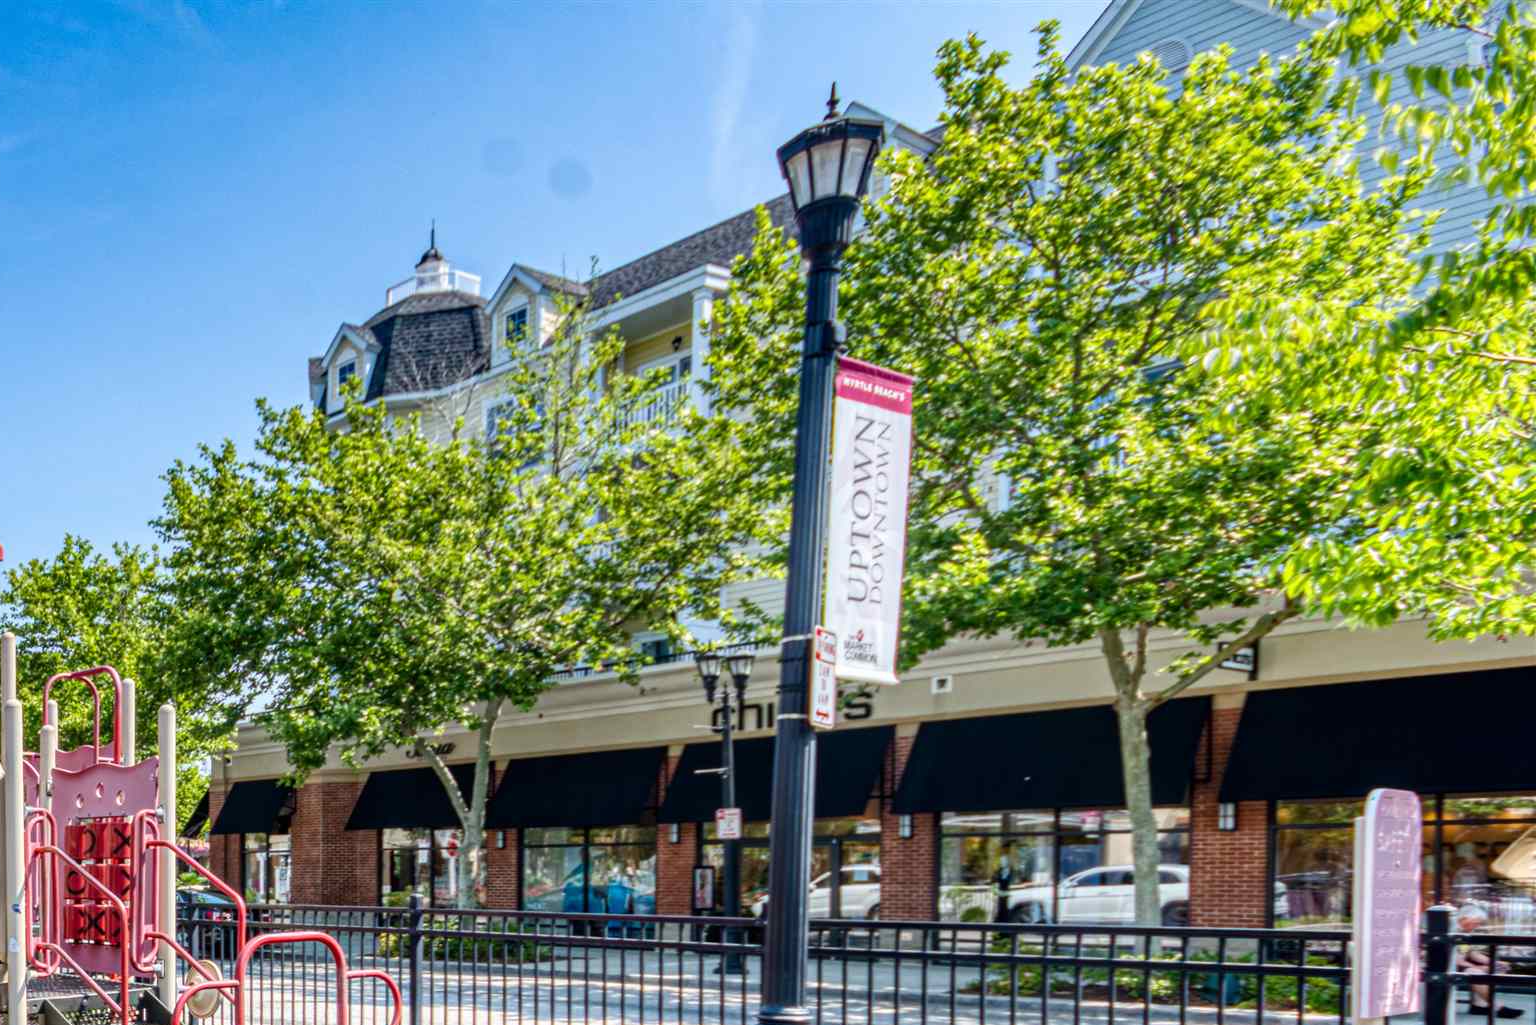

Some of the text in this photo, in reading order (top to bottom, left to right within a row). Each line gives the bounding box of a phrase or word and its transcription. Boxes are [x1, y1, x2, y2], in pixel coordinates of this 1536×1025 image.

[847, 414, 876, 603] UPTOWN
[868, 421, 891, 604] DOWNTOWN
[712, 690, 873, 733] chi's
